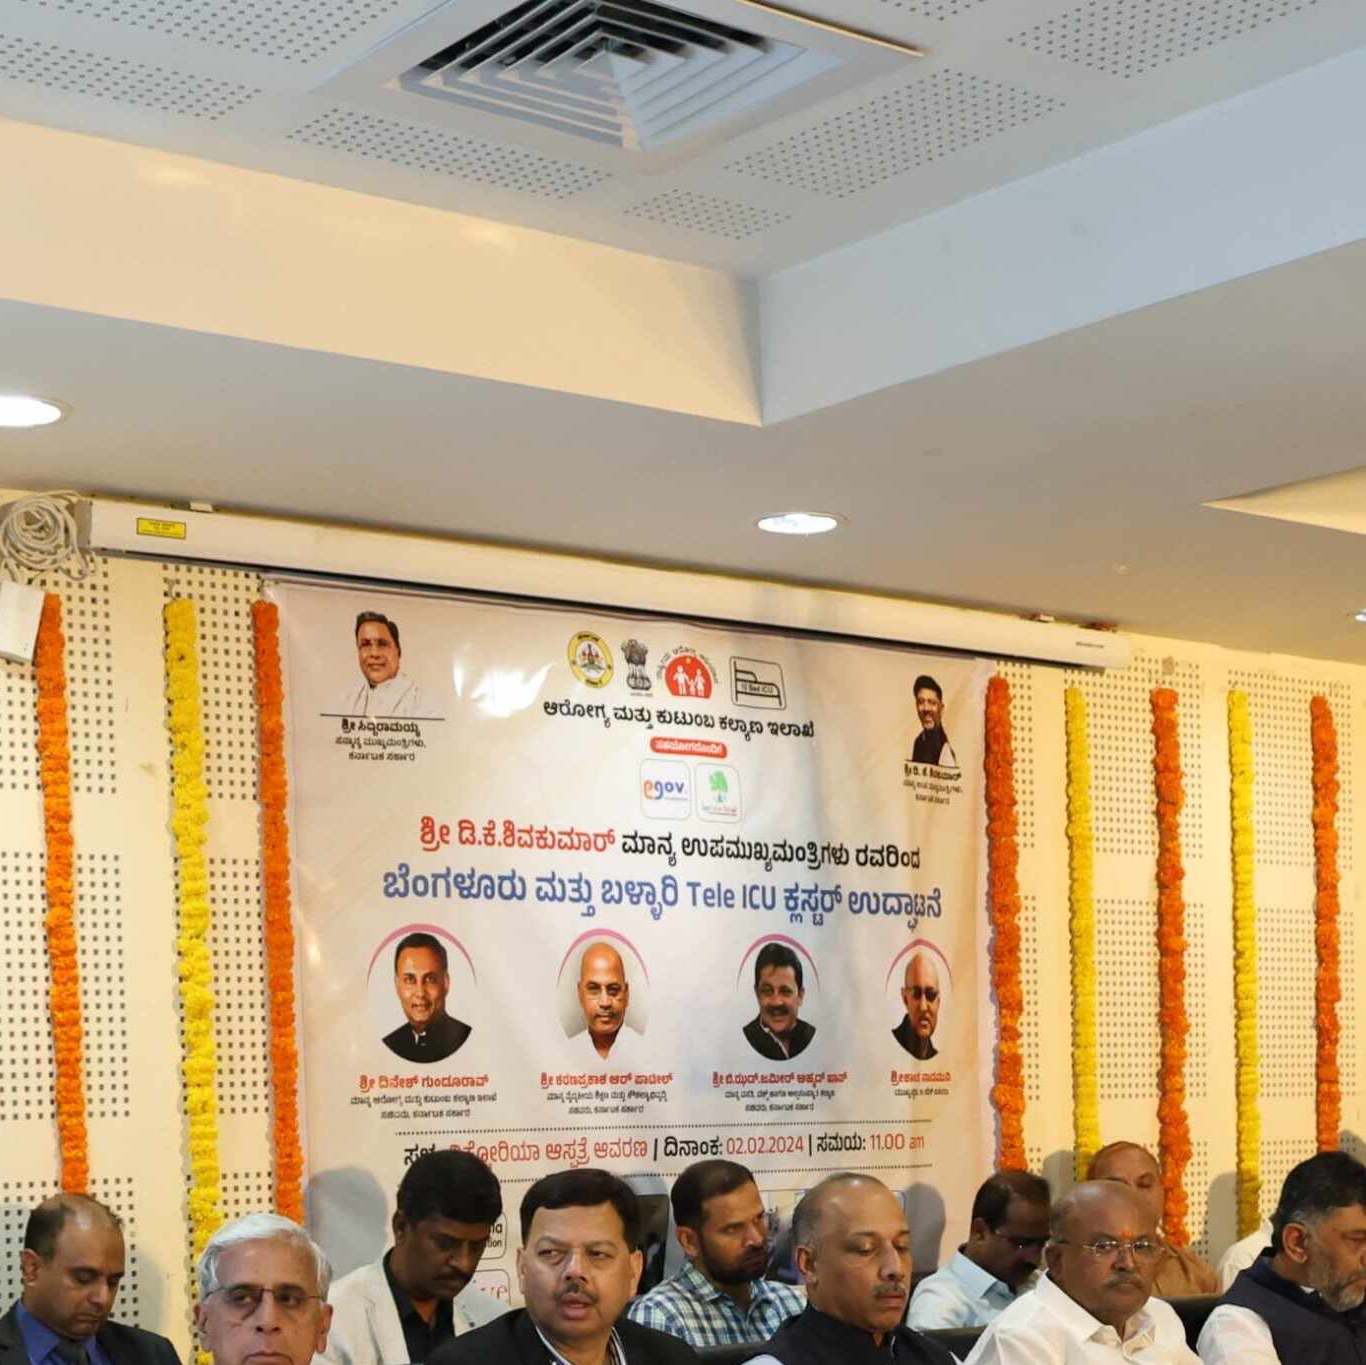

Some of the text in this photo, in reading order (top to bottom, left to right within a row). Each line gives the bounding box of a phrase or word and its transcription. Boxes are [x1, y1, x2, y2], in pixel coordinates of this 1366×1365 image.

[341, 718, 355, 734] ಶ್ರೀ
[543, 699, 815, 741] ಆರೋಗ್ಯ ಮತ್ತು ಕುಟುಂಬ ಕಲ್ಯಾಣ ಇಲಾಖೆ
[419, 816, 921, 872] ಶ್ರೀ ಡಿ.ಕೆ.ಶಿವಕುಮಾರ್ ಮಾನ್ಯ ಉಪಮುಖ್ಯಮಂತ್ರಿಗಳು ರವರಿಂದ
[383, 862, 942, 932] ಬೆಂಗಳೂರು ಮತ್ತು ಬಳ್ಳಾರಿ Tele ICU ಕ್ಲಸ್ಟರ್ ಉದ್ಘಾಟನೆ
[359, 1073, 489, 1093] ಶ್ರೀ ದಿನೇಶ್ ಗುಂಡೂರಾವ್
[540, 1072, 553, 1089] ಶ್ರೀ
[546, 1137, 591, 1169] ಆಸ್ಪತ್ರೆ
[594, 1137, 648, 1159] ಆವರಣ
[663, 1134, 723, 1157] ದಿನಾಂಕ:
[726, 1135, 804, 1155] 02.02.2024
[817, 1132, 866, 1153] ಸಮಯ:
[870, 1133, 905, 1151] 11.00
[909, 1135, 924, 1149] am
